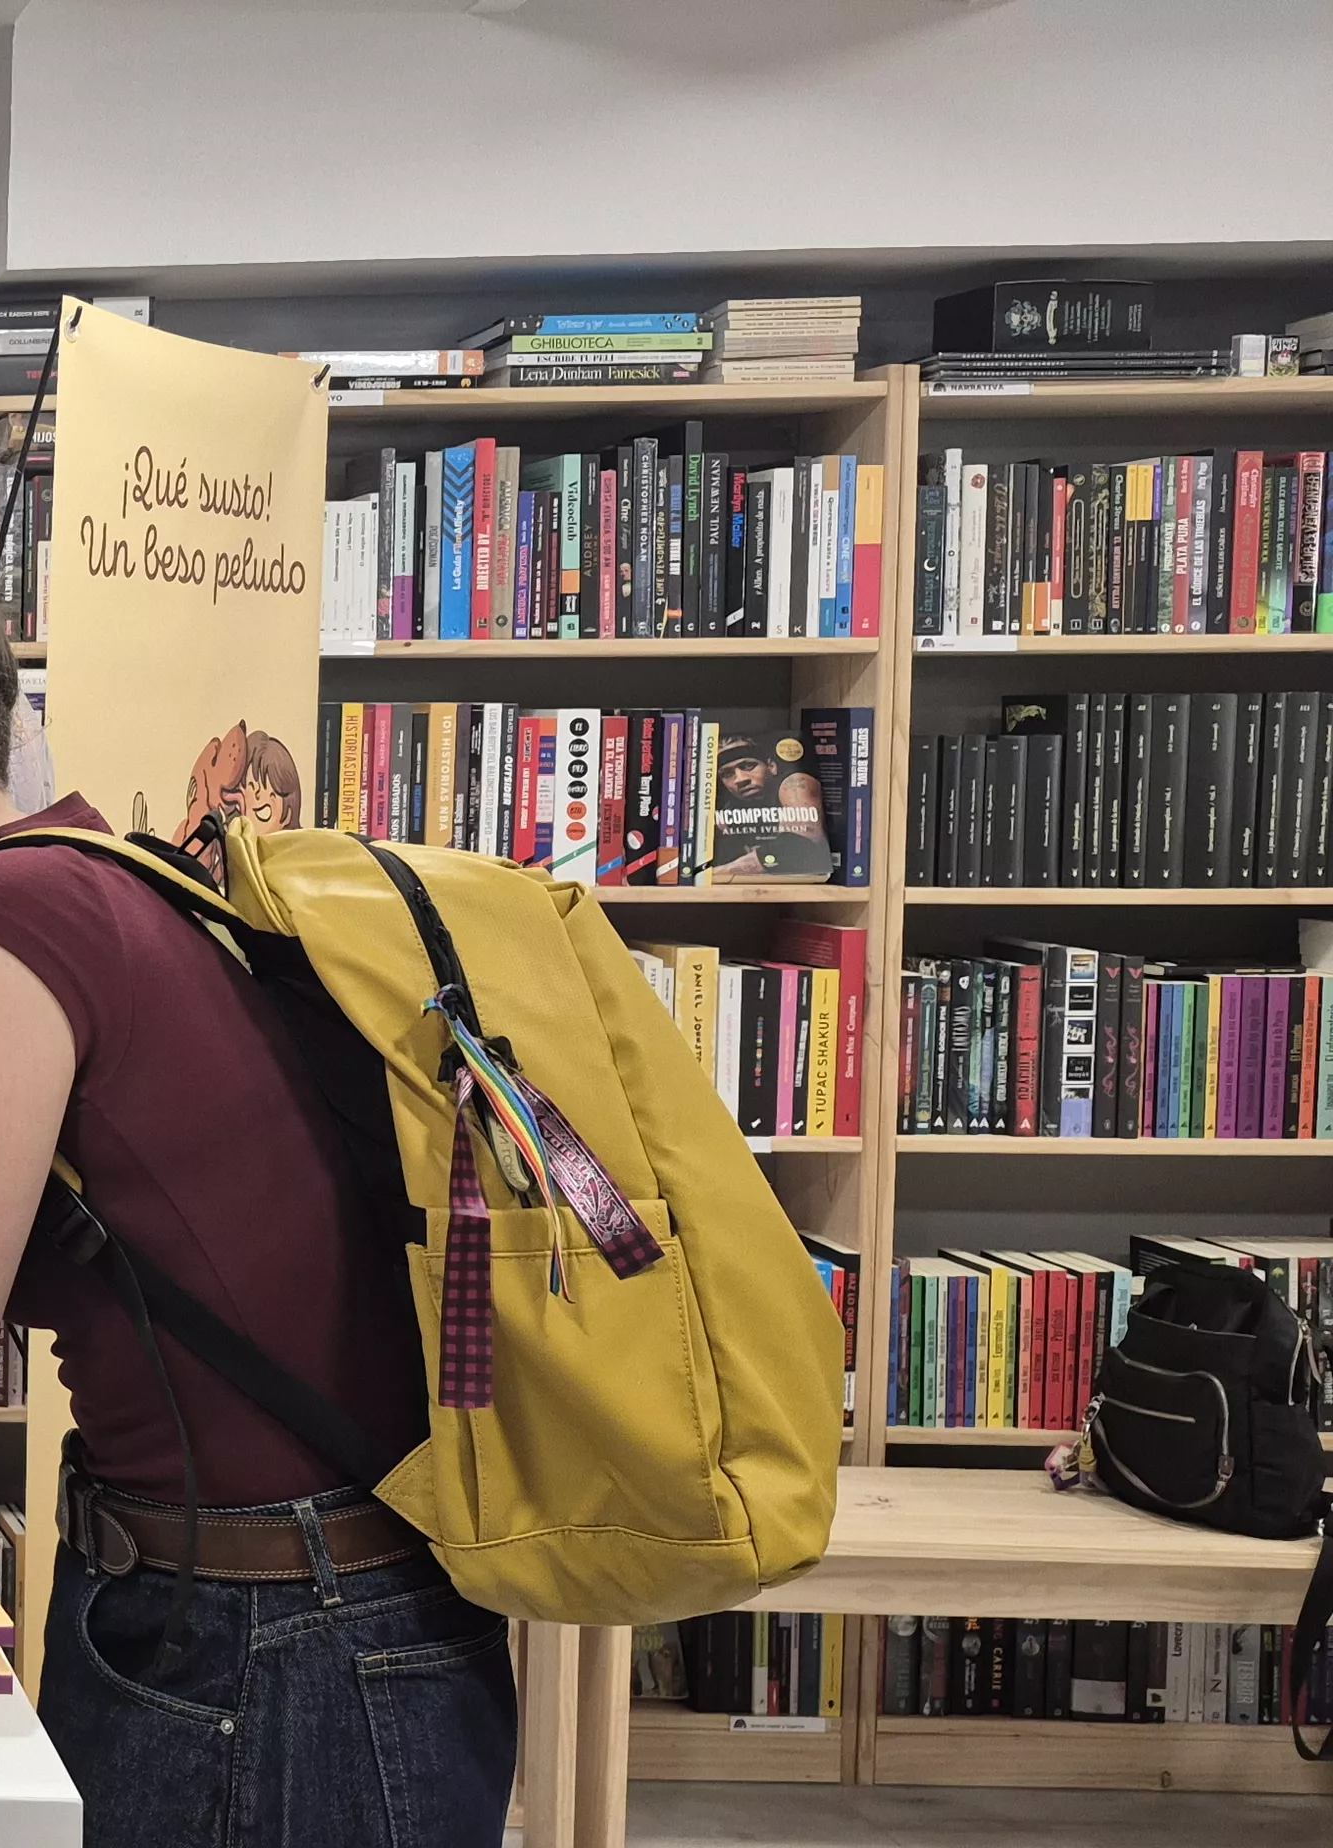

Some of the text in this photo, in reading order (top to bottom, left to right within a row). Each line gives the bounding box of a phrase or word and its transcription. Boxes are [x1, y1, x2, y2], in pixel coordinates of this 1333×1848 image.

[530, 337, 614, 350] GHIBLIOTECA
[520, 366, 547, 381] Lena
[547, 365, 603, 380] Dunham
[122, 447, 275, 523] ¡Qué susto!
[566, 480, 578, 541] Videoclub
[620, 497, 632, 523] Cine
[640, 454, 649, 562] CHRISTOPHER NOLAN
[686, 453, 702, 522] David Lynch
[709, 459, 721, 546] PAUL NEWMAN
[731, 472, 746, 548] Marilyn Mailer
[1112, 474, 1123, 505] Charles
[80, 515, 135, 579] Un
[143, 522, 206, 586] beso
[212, 531, 307, 605] peludo
[583, 524, 593, 578] AUDREY
[841, 537, 851, 561] CINE
[1176, 518, 1189, 575] PLATA PURA
[1193, 539, 1204, 554] LAS
[1193, 556, 1204, 566] DE
[1191, 567, 1203, 595] CÓDICE
[1192, 596, 1202, 606] EL
[341, 714, 359, 824] HISTORIAS DEL DRAFT
[439, 715, 453, 832] 101 HISTORIAS NBA
[502, 755, 514, 806] OUTSIDER
[704, 735, 714, 811] COAST TO COAST
[857, 727, 869, 788] SUPER BOWL
[715, 806, 819, 826] NCOMPRENDIDO
[722, 825, 809, 835] ALLEN IVERSON
[694, 963, 704, 1064] DANIEL JOHNSTO
[815, 1011, 829, 1114] TUPAC SHAKUR
